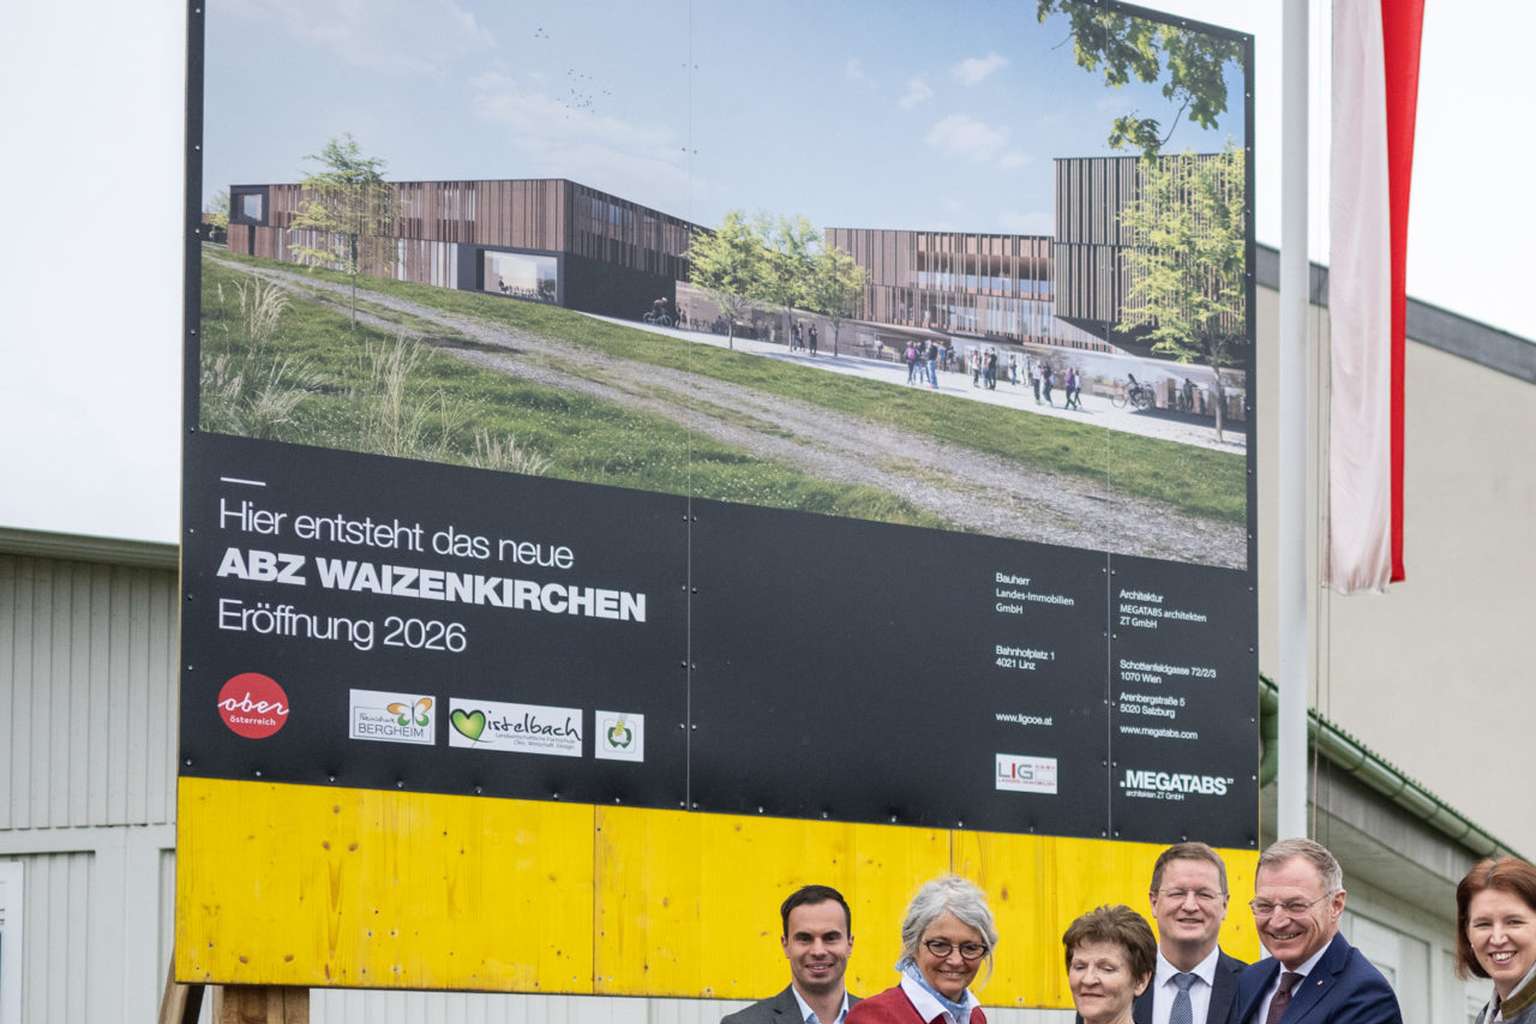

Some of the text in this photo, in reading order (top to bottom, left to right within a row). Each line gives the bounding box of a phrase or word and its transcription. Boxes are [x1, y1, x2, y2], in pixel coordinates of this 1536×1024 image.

[220, 498, 575, 569] Hier entsteht das neue
[216, 547, 647, 623] ABZ WAIZENKIRCHEN
[995, 572, 1031, 586] Bauherr
[995, 587, 1075, 606] Landes-Immobilien
[1119, 589, 1164, 603] Architektur
[995, 602, 1024, 614] GmbH
[1119, 604, 1207, 623] MEGATABS architekten
[218, 597, 467, 653] Eröffnung 2026
[1119, 616, 1158, 629] ZT GmbH
[995, 657, 1037, 671] 4021 Linz
[1120, 671, 1141, 682] 1070
[217, 691, 290, 716] ober
[358, 722, 425, 738] BERGHEIM
